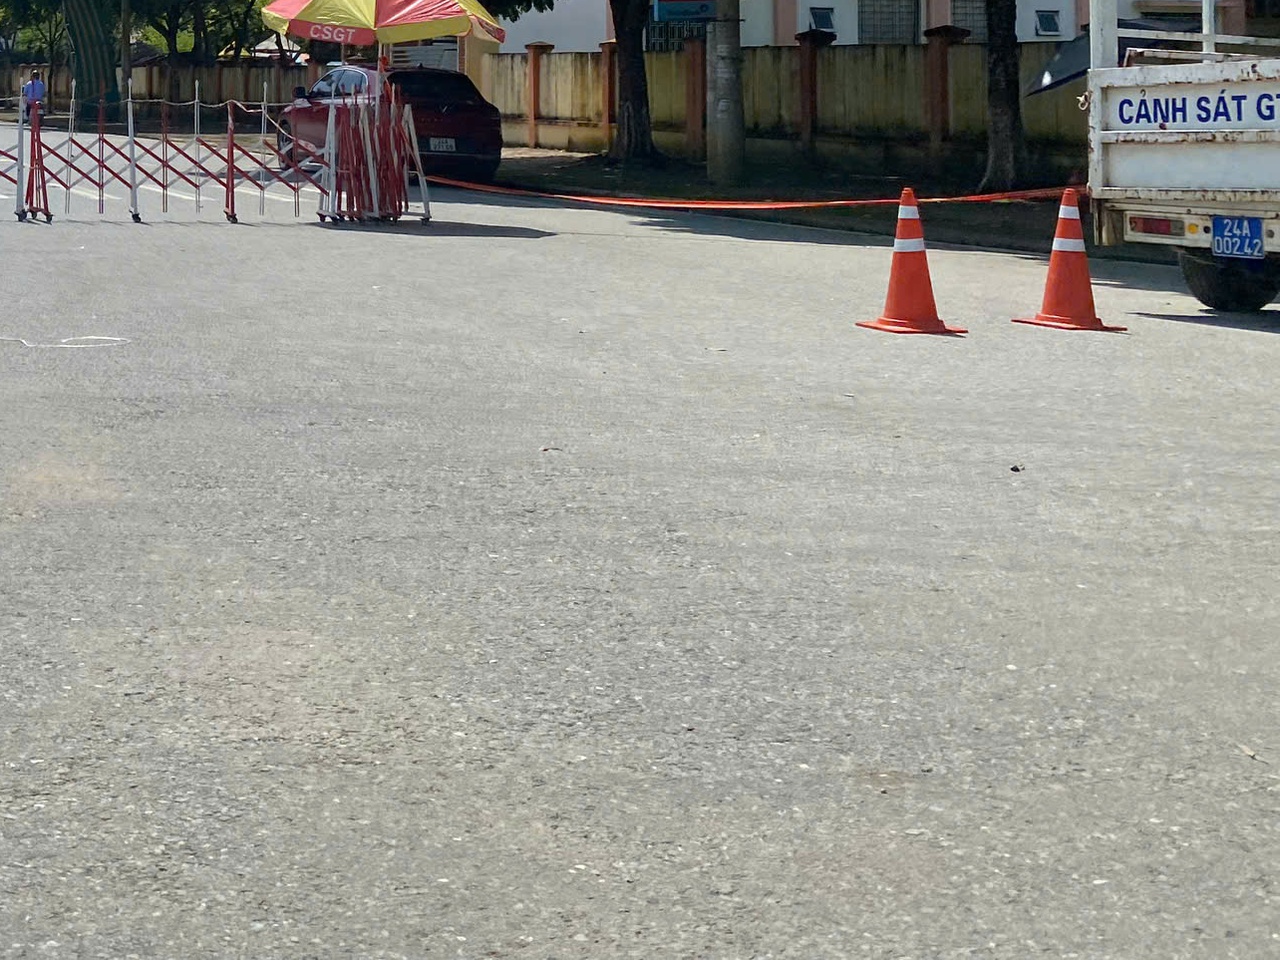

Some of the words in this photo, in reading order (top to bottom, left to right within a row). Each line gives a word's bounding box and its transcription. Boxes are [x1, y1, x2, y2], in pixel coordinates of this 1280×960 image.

[310, 24, 355, 43] CSGT
[1119, 89, 1187, 124] CẢNH
[1196, 89, 1247, 122] SÁT
[1256, 93, 1280, 121] G
[1224, 219, 1250, 236] 24A
